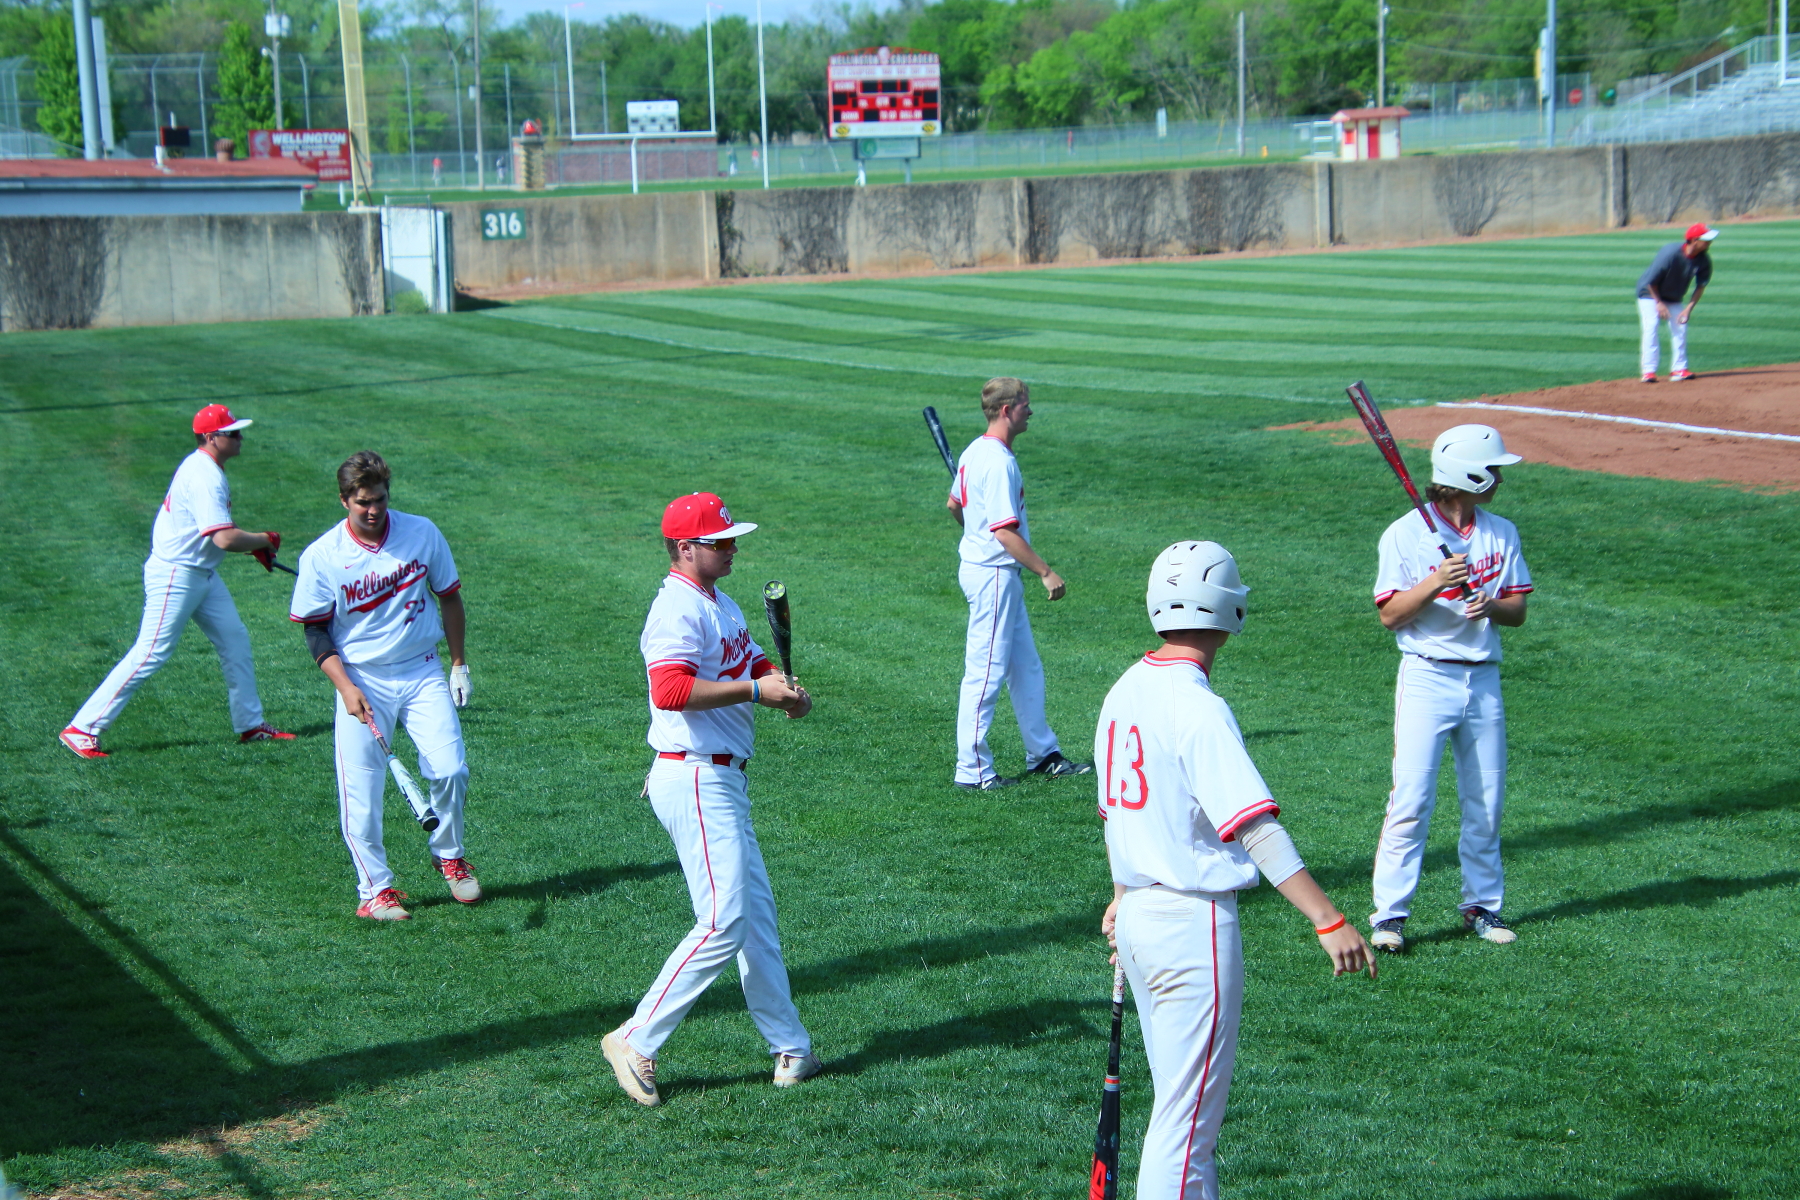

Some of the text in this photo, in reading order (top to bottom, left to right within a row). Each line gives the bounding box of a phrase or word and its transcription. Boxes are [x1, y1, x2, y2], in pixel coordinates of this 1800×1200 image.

[272, 132, 346, 145] WELLINGTON
[484, 211, 523, 239] 316
[340, 558, 424, 606] Wellington
[1106, 718, 1150, 813] 13
